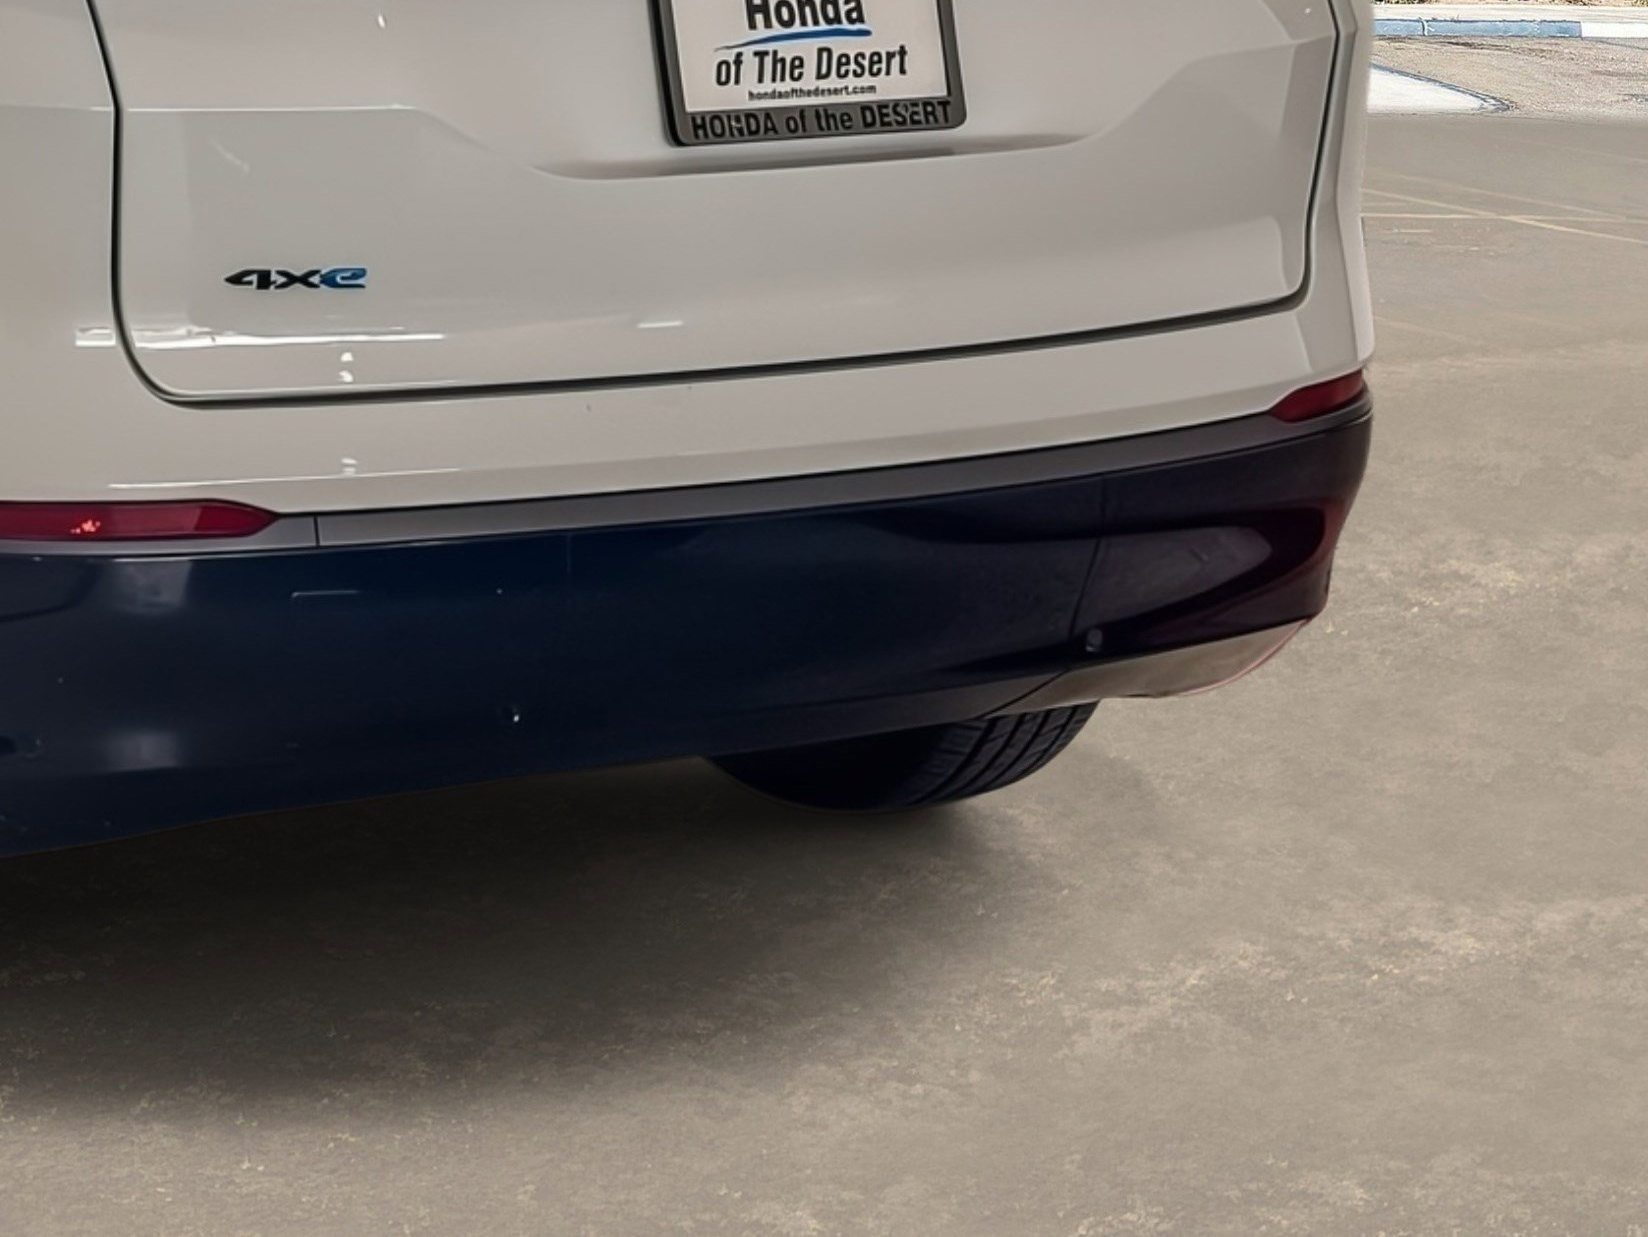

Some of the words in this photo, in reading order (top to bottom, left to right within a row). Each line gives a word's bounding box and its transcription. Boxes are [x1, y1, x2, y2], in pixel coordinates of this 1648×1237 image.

[715, 51, 743, 86] of
[753, 49, 804, 84] The
[815, 44, 908, 81] Desert
[748, 83, 877, 101] hondaofthedesert.com
[690, 112, 779, 140] HONDA
[784, 110, 808, 133] of
[815, 109, 853, 132] the
[860, 100, 952, 129] DESERT
